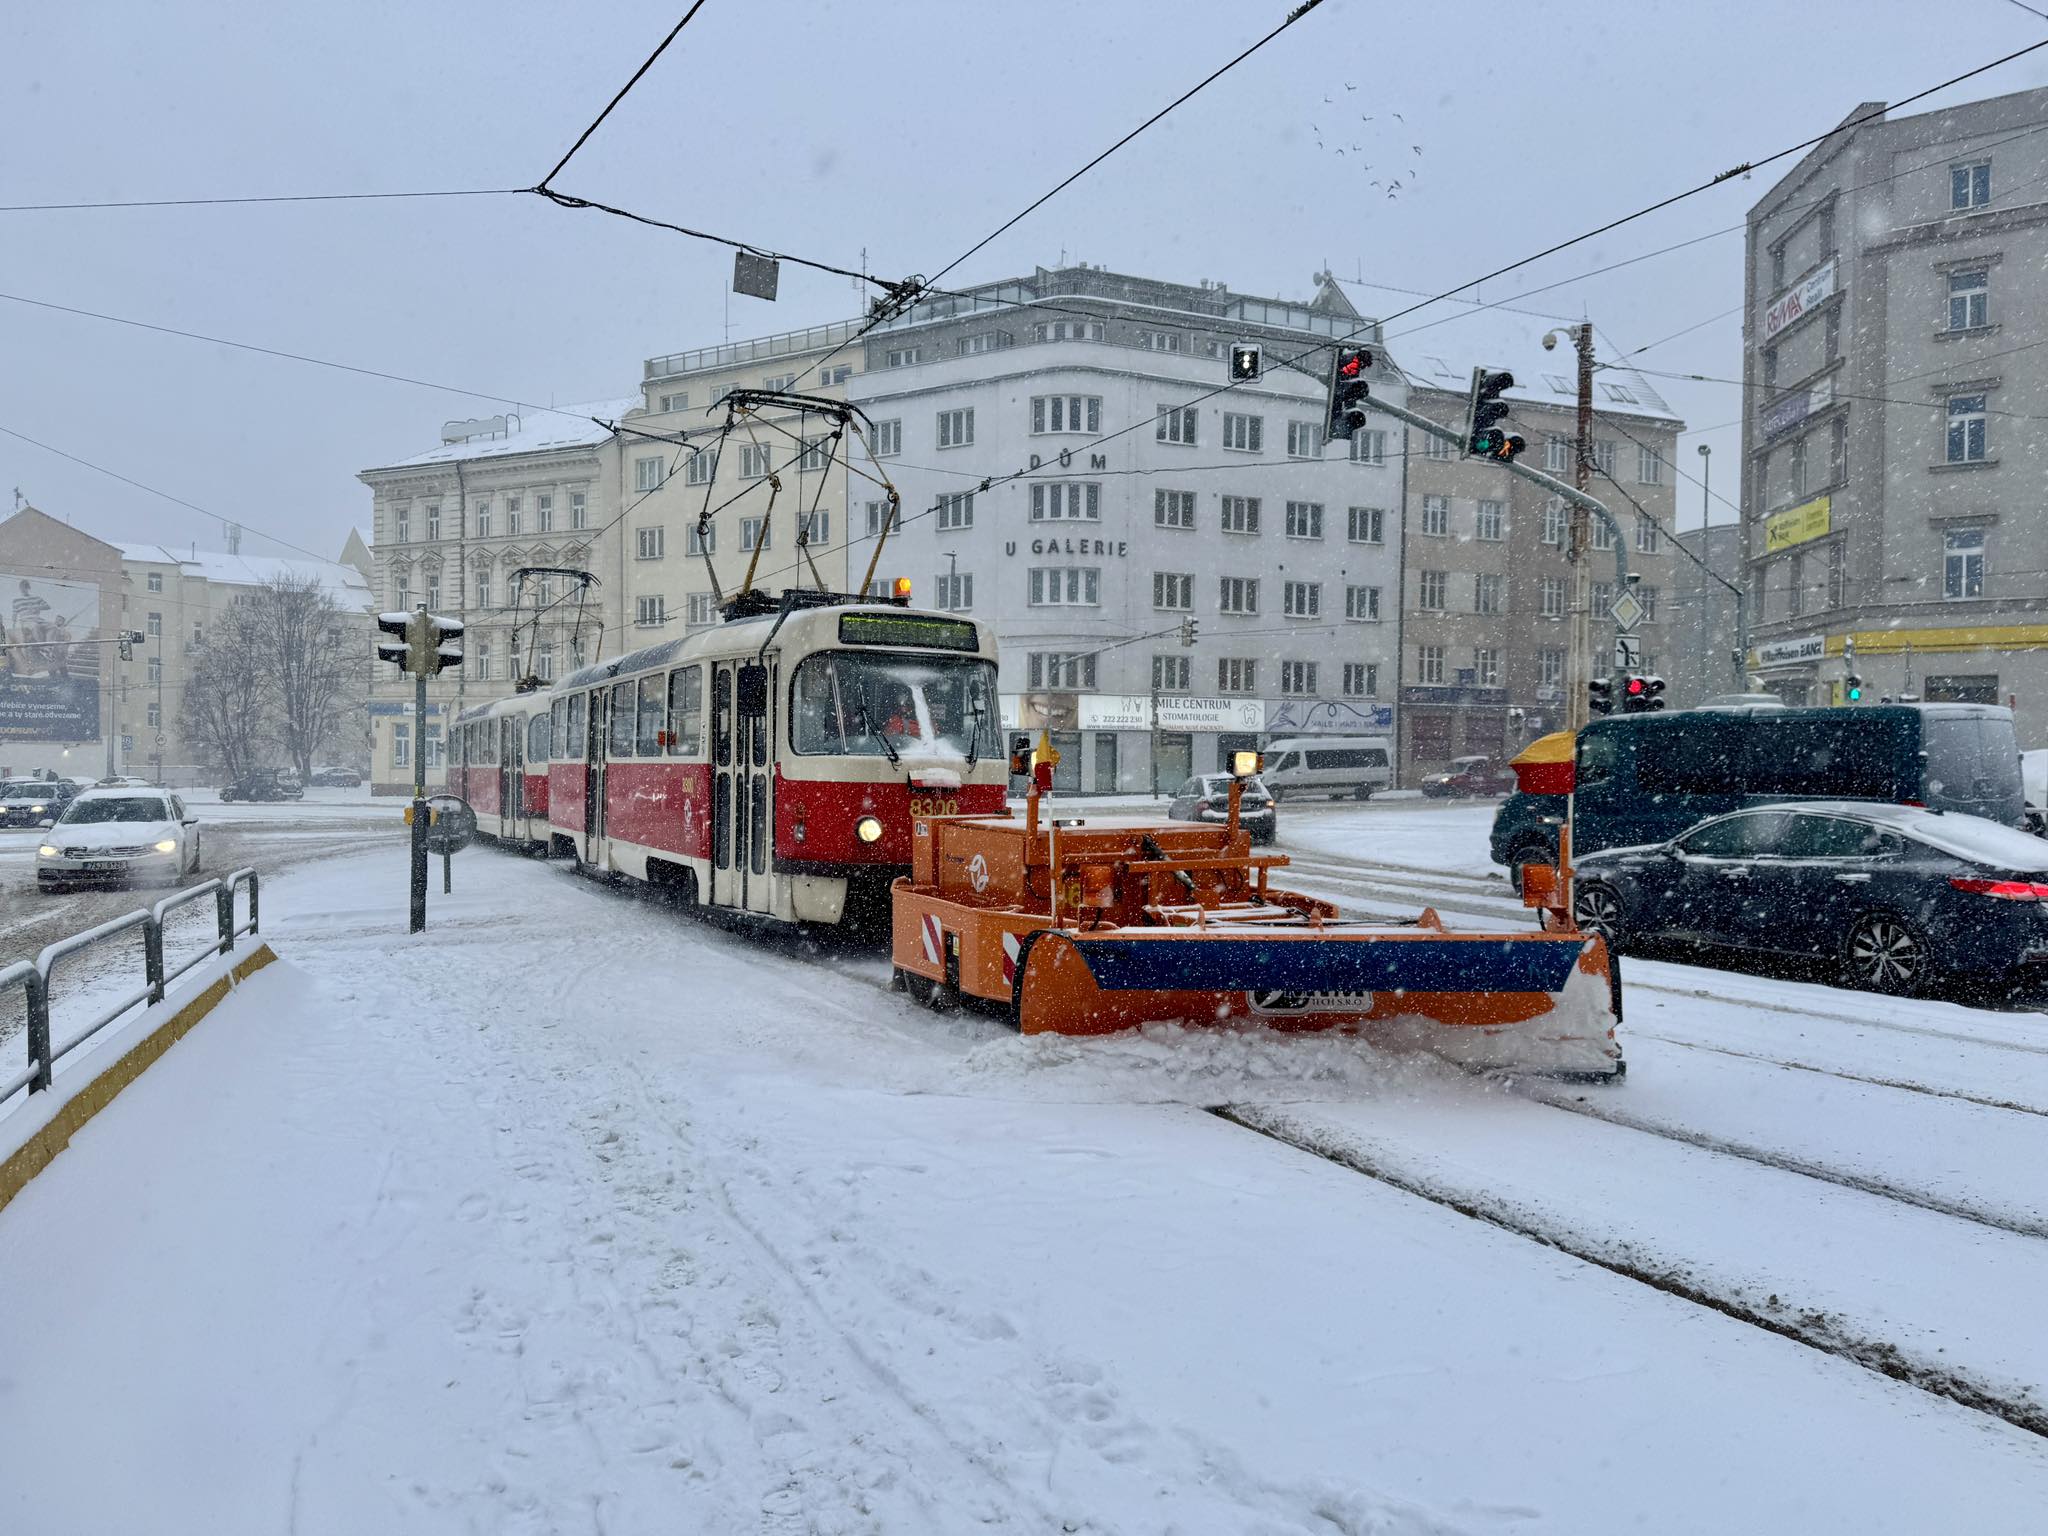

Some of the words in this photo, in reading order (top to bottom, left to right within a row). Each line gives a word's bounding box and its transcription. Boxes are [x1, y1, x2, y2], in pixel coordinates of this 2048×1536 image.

[1030, 447, 1106, 470] DŮM
[1006, 542, 1016, 556] U
[1032, 539, 1128, 557] GALERIE
[1151, 698, 1180, 709] MILE
[1183, 699, 1231, 710] CENTRUM
[1163, 713, 1219, 722] STOMATOLOGIE
[909, 799, 957, 817] 8300
